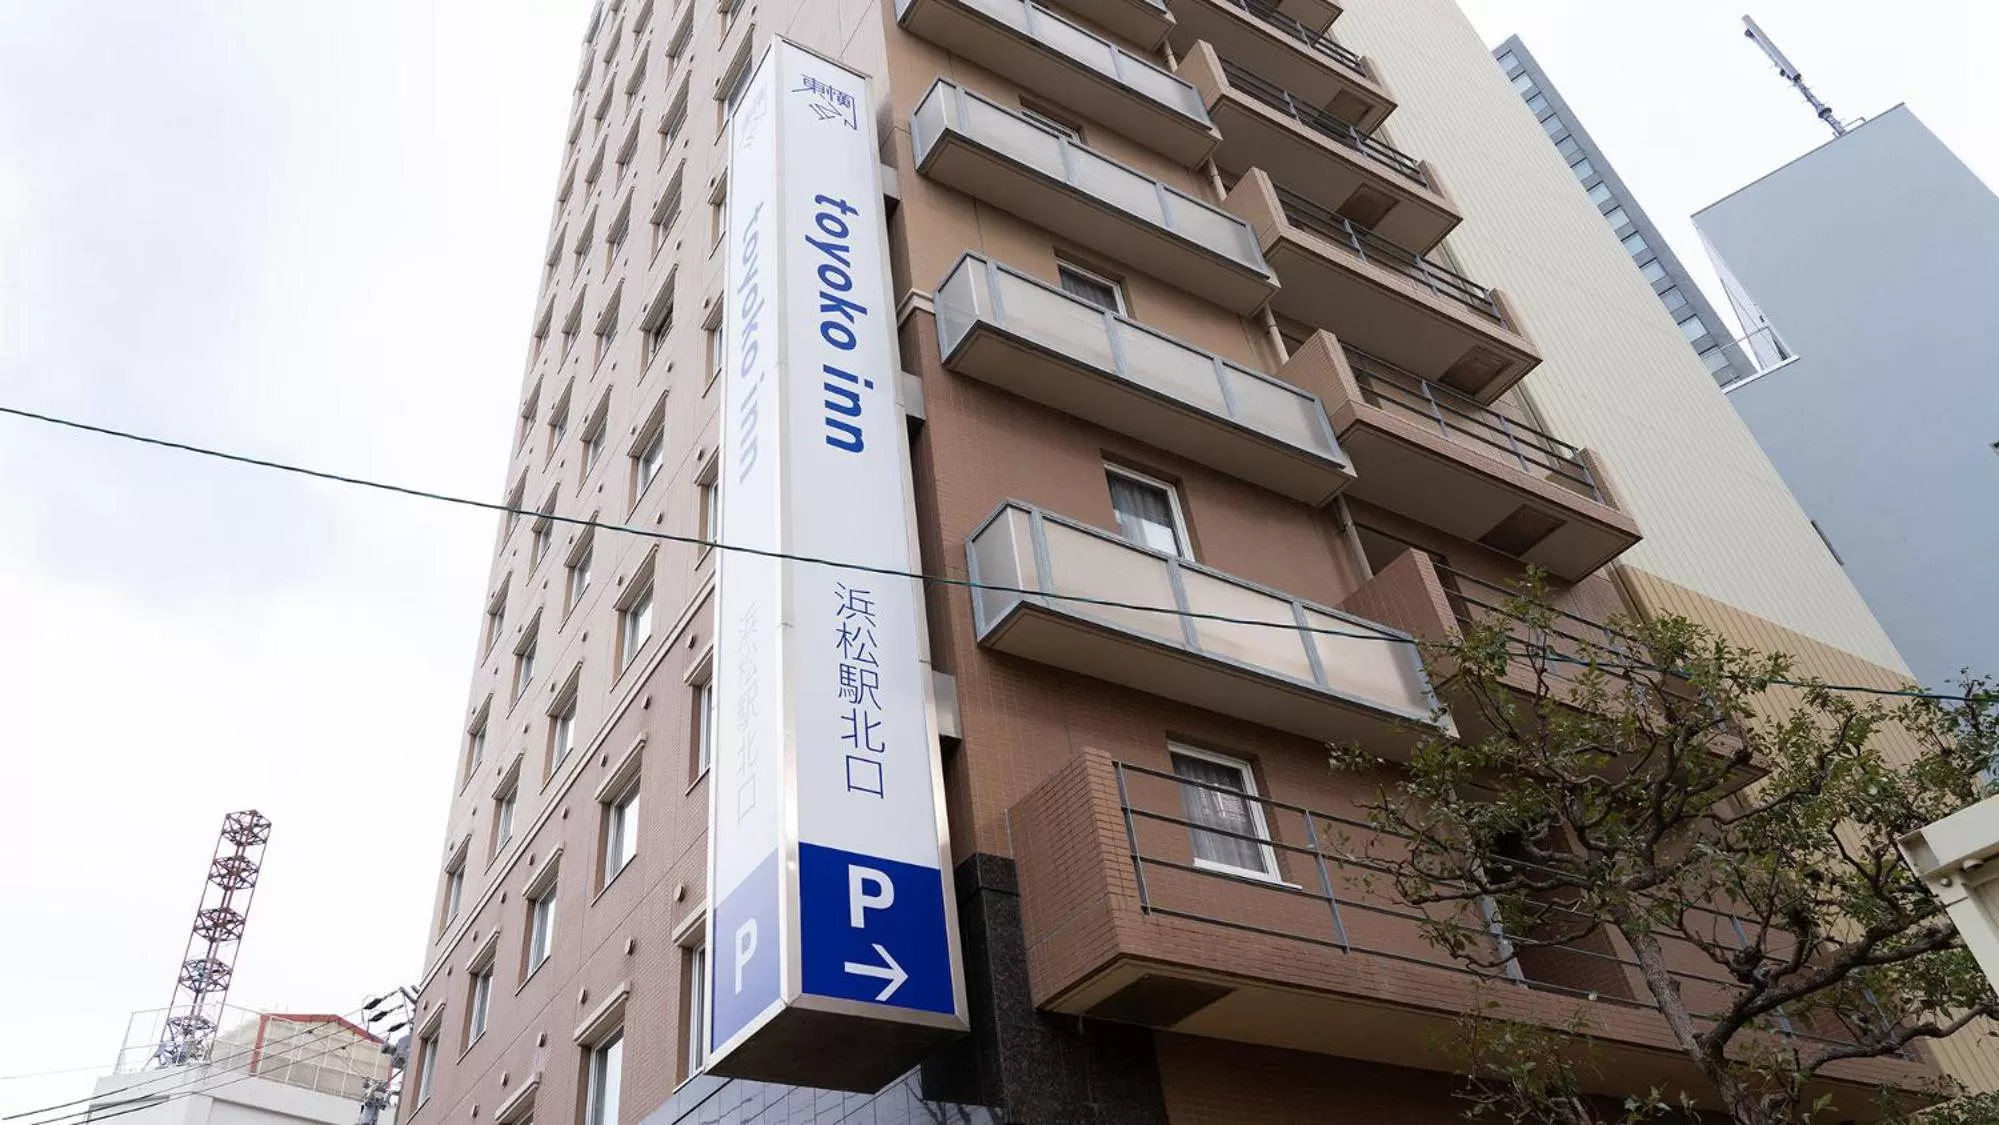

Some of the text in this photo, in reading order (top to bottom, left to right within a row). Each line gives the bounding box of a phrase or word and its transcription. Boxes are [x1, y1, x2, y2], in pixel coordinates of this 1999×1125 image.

[738, 202, 766, 484] toyoko inn
[804, 194, 874, 454] toyoko inn
[834, 581, 885, 799] 浜松駅北口
[736, 917, 757, 995] P
[848, 864, 894, 928] P
